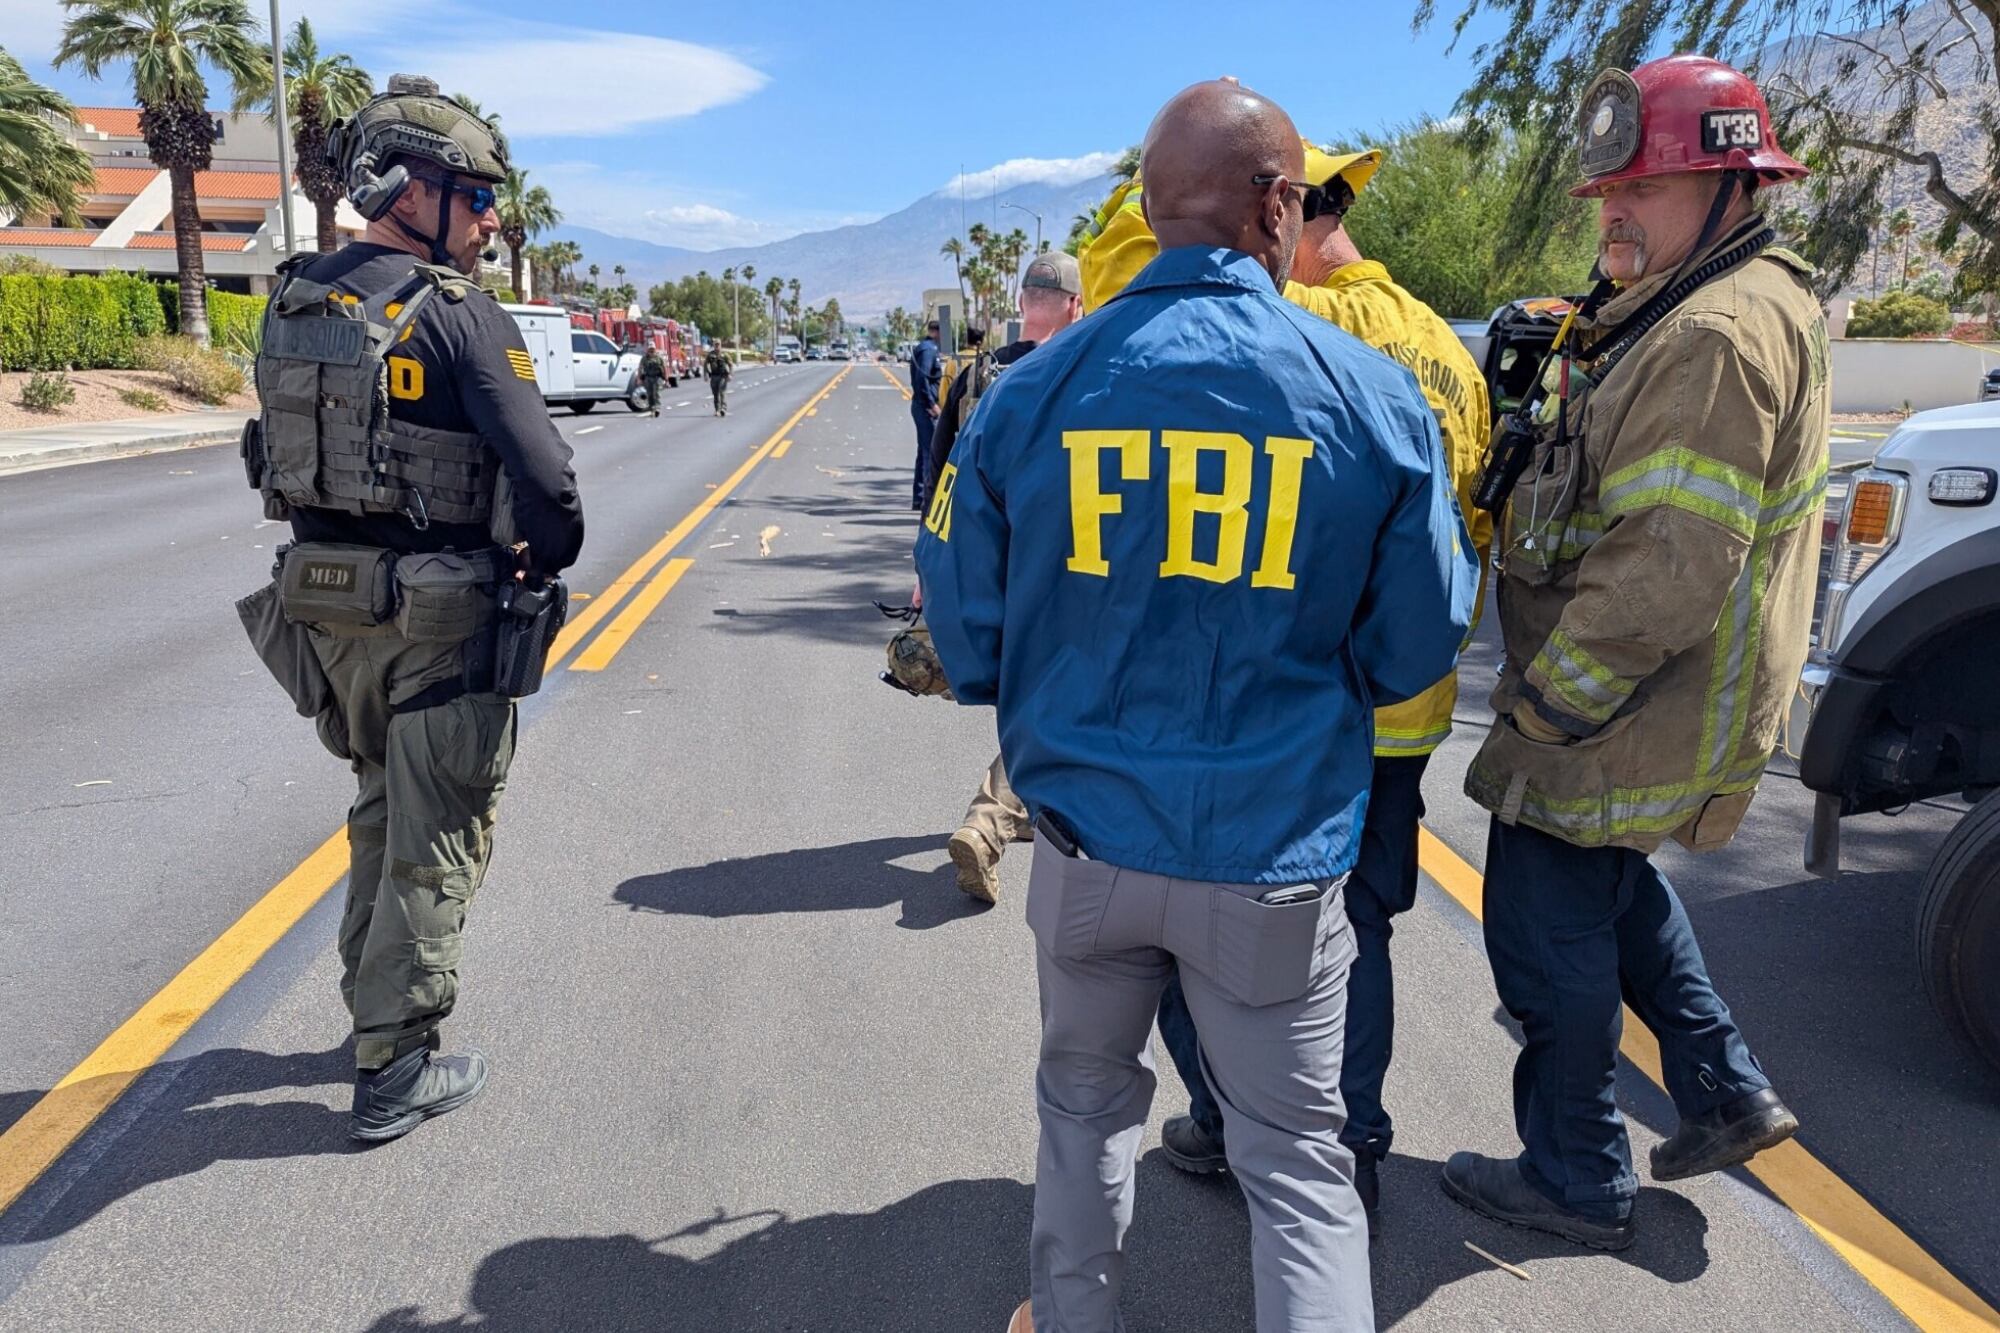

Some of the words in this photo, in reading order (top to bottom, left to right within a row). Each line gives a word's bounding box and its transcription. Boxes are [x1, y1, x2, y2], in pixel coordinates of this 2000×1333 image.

[1710, 113, 1759, 147] T33
[1420, 355, 1468, 416] COUNTY
[925, 462, 957, 542] BI
[1062, 430, 1314, 590] FBI
[308, 567, 349, 585] MED
